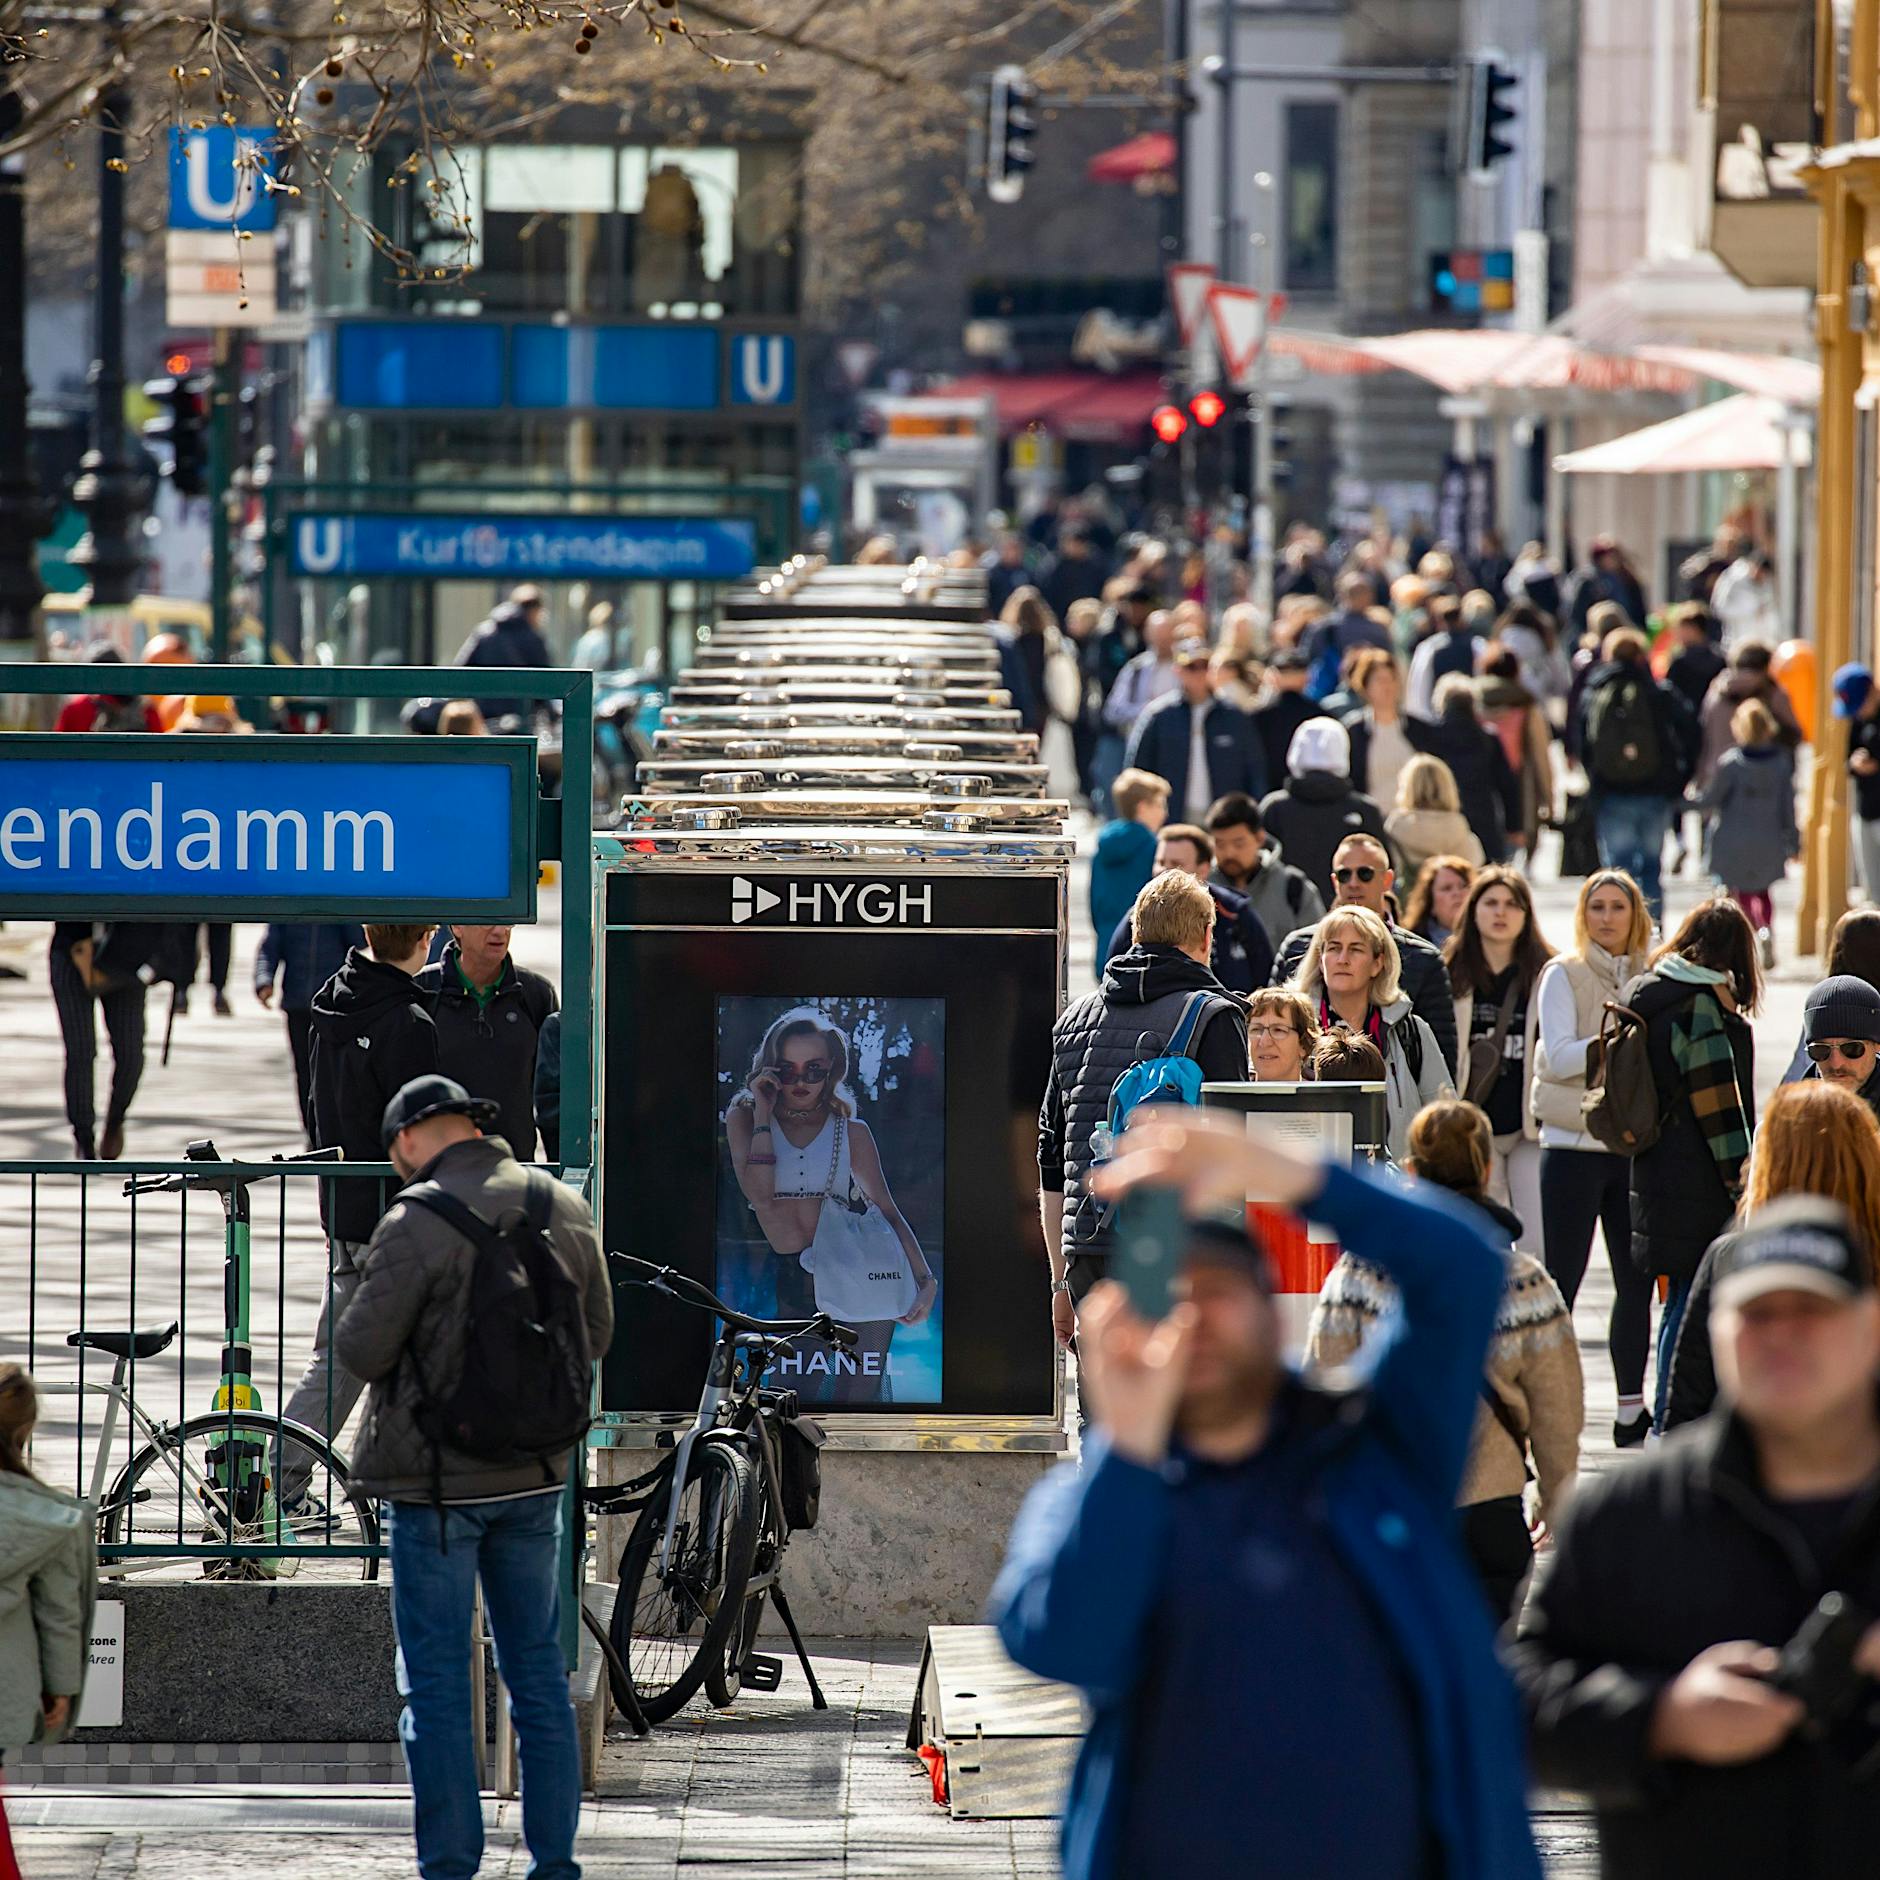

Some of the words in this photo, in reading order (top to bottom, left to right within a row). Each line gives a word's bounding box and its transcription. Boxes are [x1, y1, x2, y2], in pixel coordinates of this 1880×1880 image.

[187, 136, 257, 222] U
[741, 334, 785, 404] U
[300, 518, 343, 573] U
[0, 782, 394, 872] endamm
[789, 883, 932, 923] HYGH
[868, 1271, 902, 1281] CHANEL
